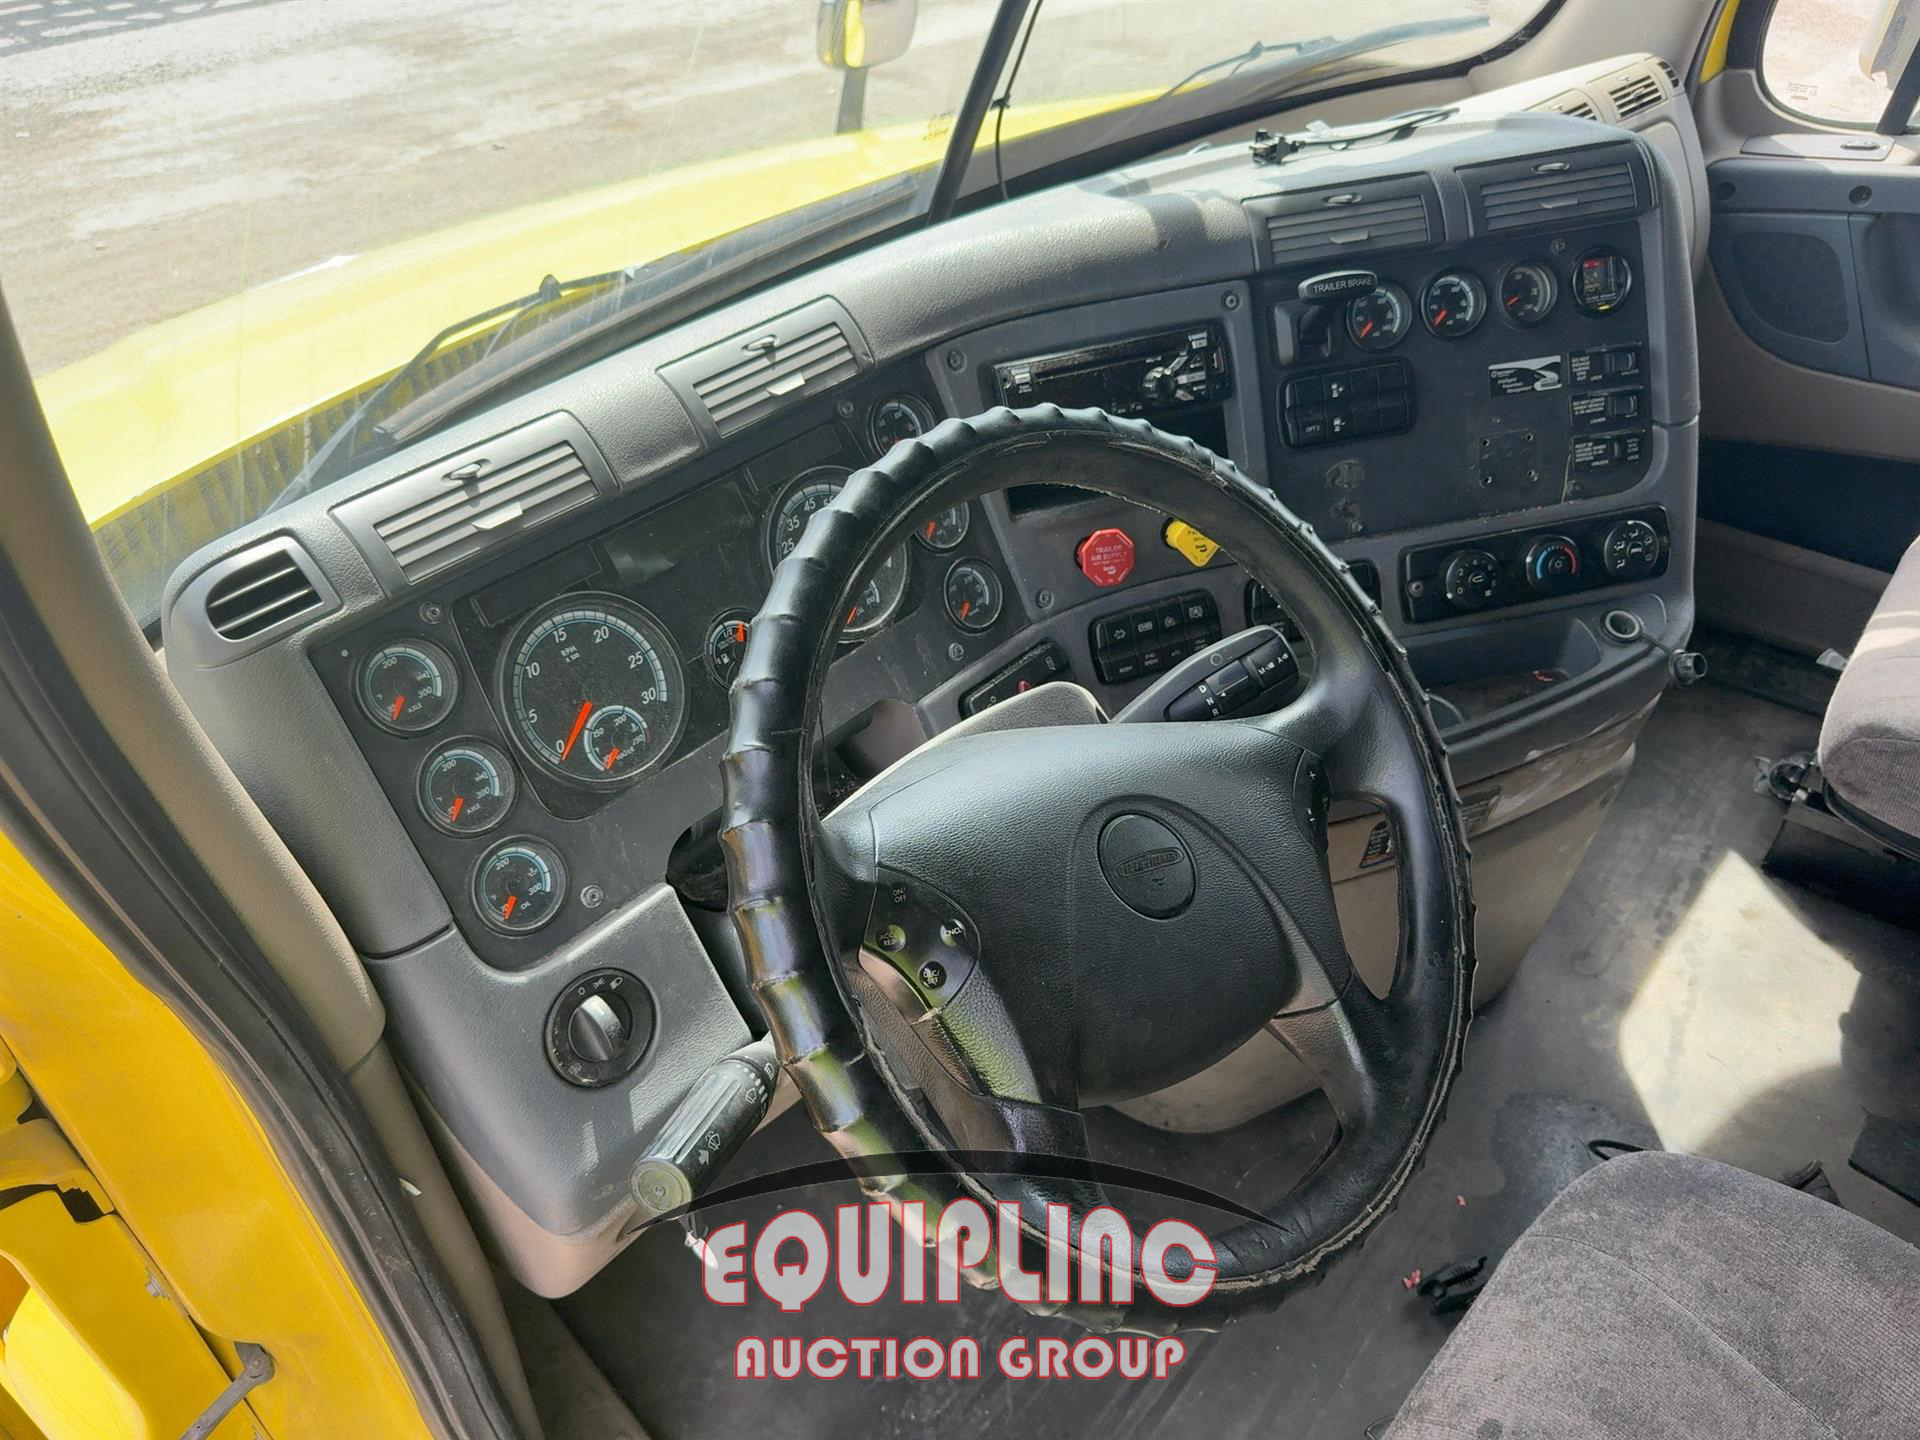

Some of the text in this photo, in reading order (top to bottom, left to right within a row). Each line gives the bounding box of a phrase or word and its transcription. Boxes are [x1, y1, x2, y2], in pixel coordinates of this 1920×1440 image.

[1313, 276, 1373, 294] TRAILER BRAKE
[804, 498, 816, 512] 45
[786, 515, 800, 532] 35
[781, 538, 795, 555] 25
[553, 626, 568, 644] 15
[593, 625, 610, 644] 20
[628, 650, 644, 669] 25
[525, 662, 541, 678] 10
[641, 687, 656, 705] 30
[1198, 684, 1207, 694] D
[1206, 696, 1214, 706] N
[528, 708, 538, 724] 5
[1211, 708, 1219, 717] R
[556, 739, 565, 754] 0
[943, 926, 962, 937] CNCL
